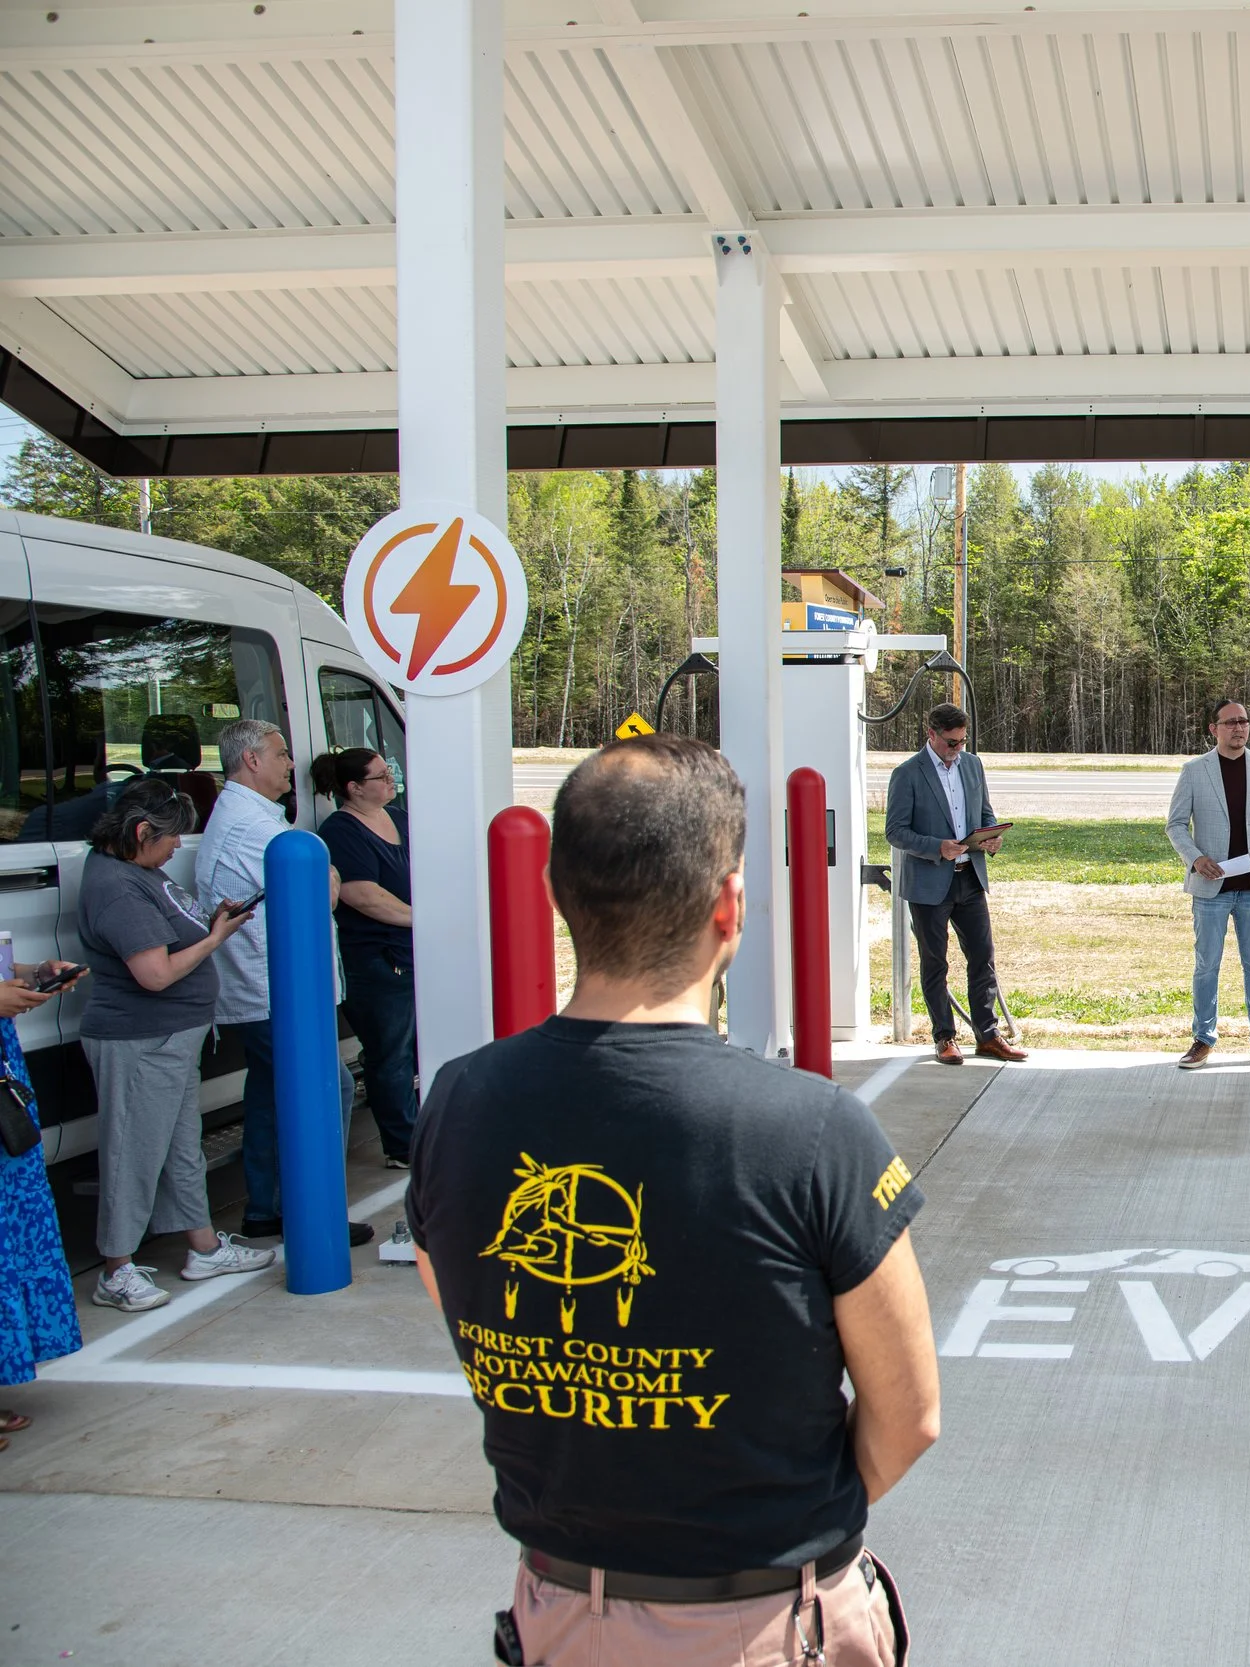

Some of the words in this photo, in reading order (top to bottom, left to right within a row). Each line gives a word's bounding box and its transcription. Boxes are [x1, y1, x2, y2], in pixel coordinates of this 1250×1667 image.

[458, 1319, 554, 1358] FOREST
[562, 1339, 715, 1369] COUNTY
[462, 1360, 731, 1430] SECURITY
[473, 1347, 683, 1394] POTAWATOMI
